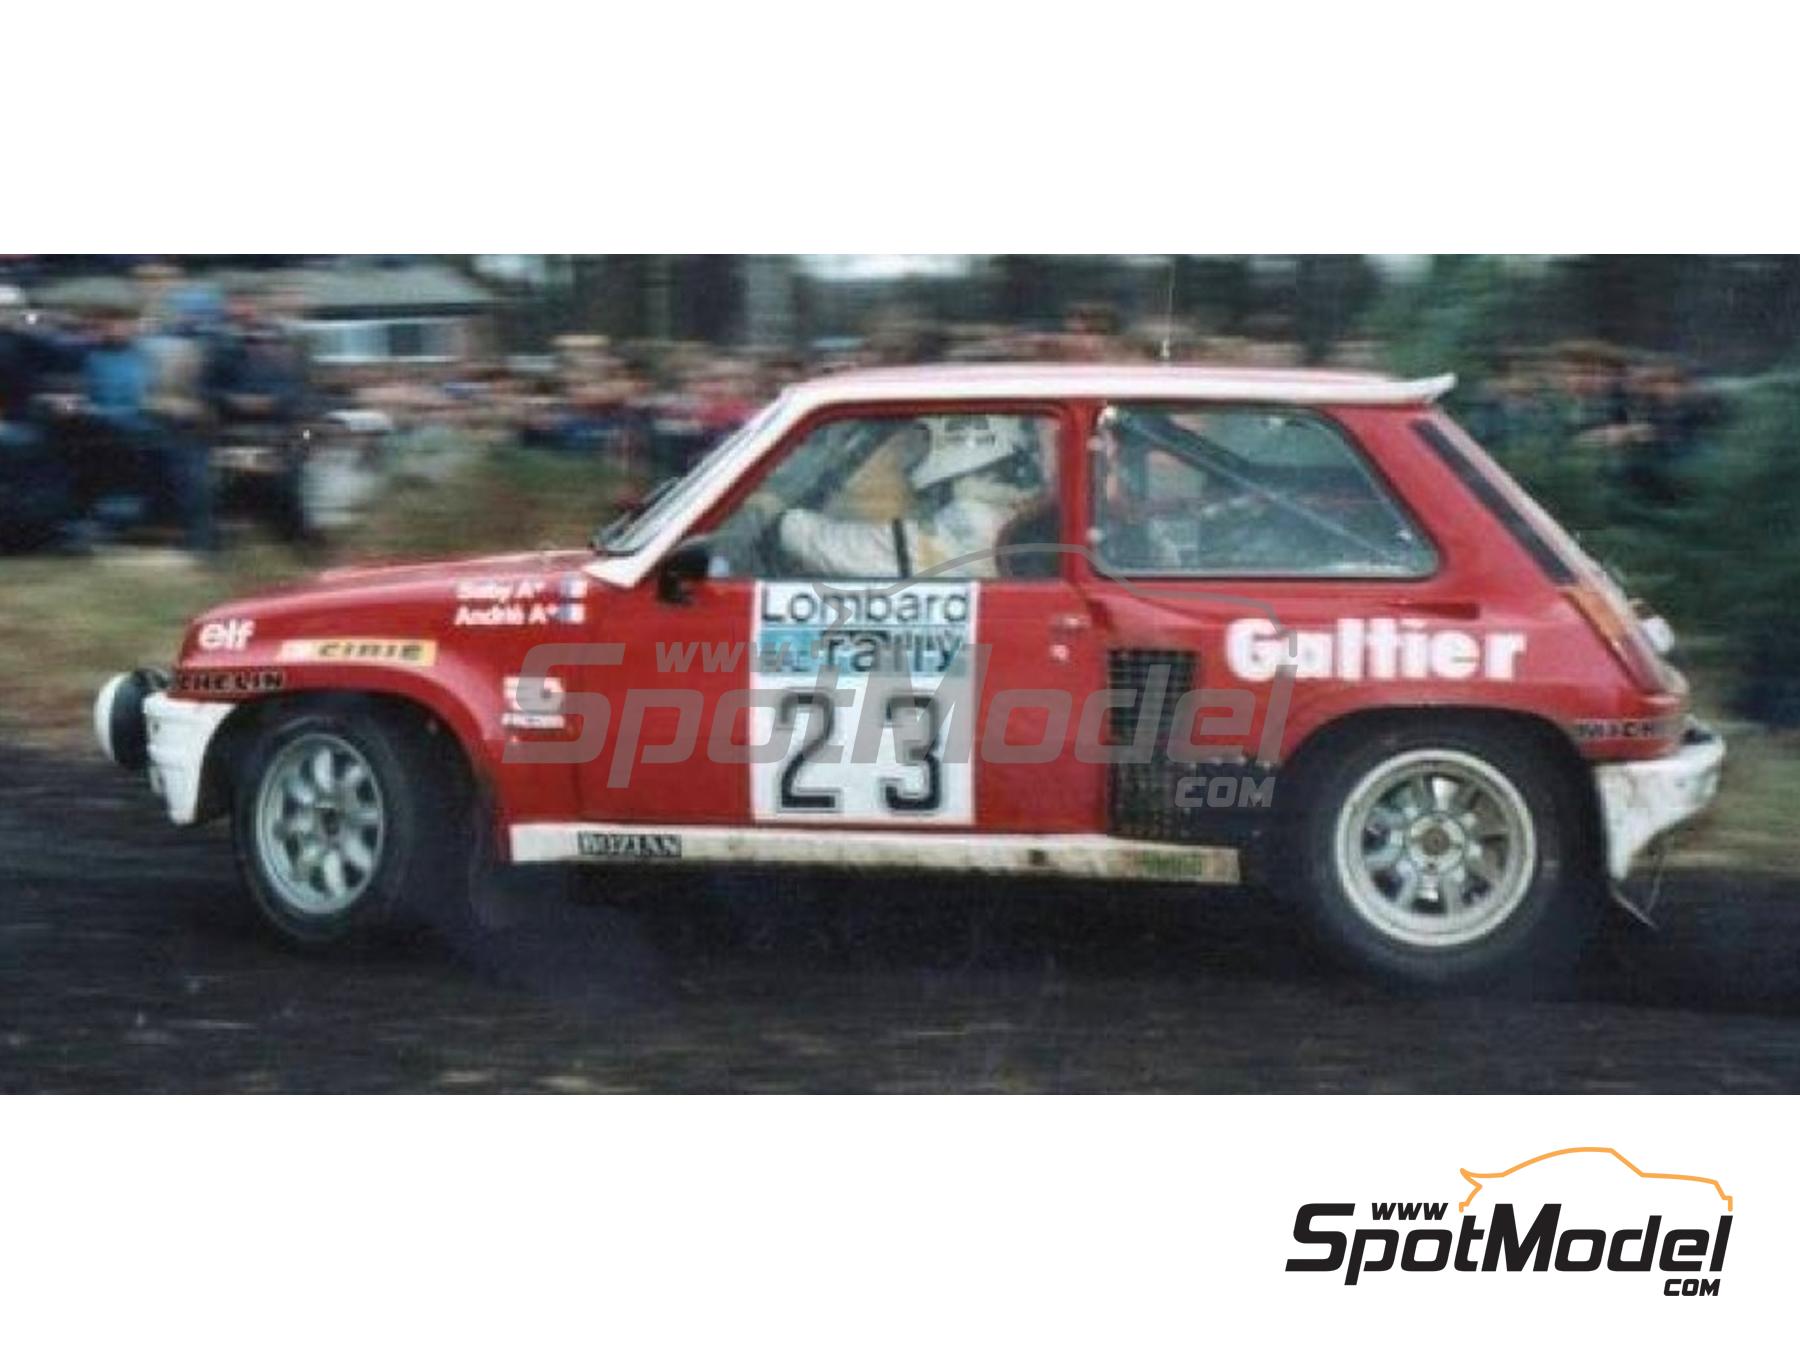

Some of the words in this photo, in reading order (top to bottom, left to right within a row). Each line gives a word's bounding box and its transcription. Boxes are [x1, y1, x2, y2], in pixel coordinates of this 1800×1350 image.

[761, 586, 968, 622] Lombard
[199, 619, 255, 649] elf
[827, 632, 963, 673] rally
[1225, 617, 1526, 682] Galtier
[778, 686, 943, 814] 23
